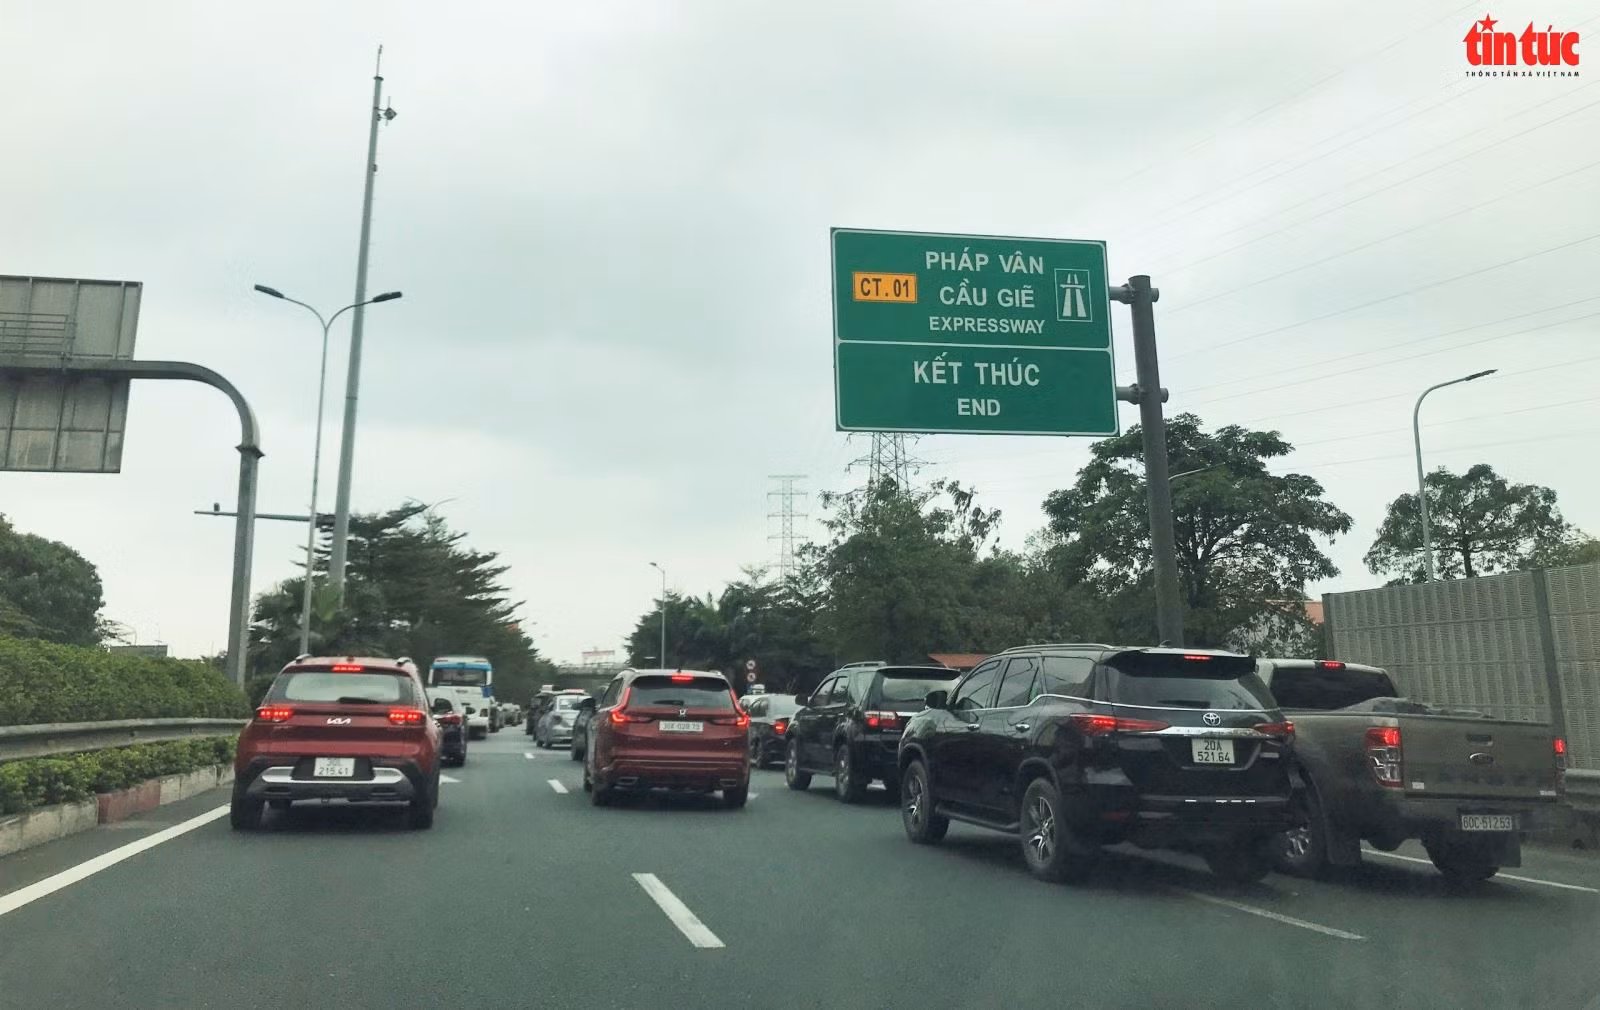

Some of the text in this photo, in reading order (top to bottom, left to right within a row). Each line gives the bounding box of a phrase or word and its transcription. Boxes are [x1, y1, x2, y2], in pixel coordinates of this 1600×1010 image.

[925, 247, 1044, 274] PHÁP VÂN
[939, 278, 1036, 308] CẦU GIẼ
[929, 316, 1046, 334] EXPRESSWAY
[913, 352, 1041, 386] KẾT THÚC
[957, 398, 1001, 416] END
[1204, 740, 1222, 751] 20A
[1197, 751, 1230, 762] 521.64
